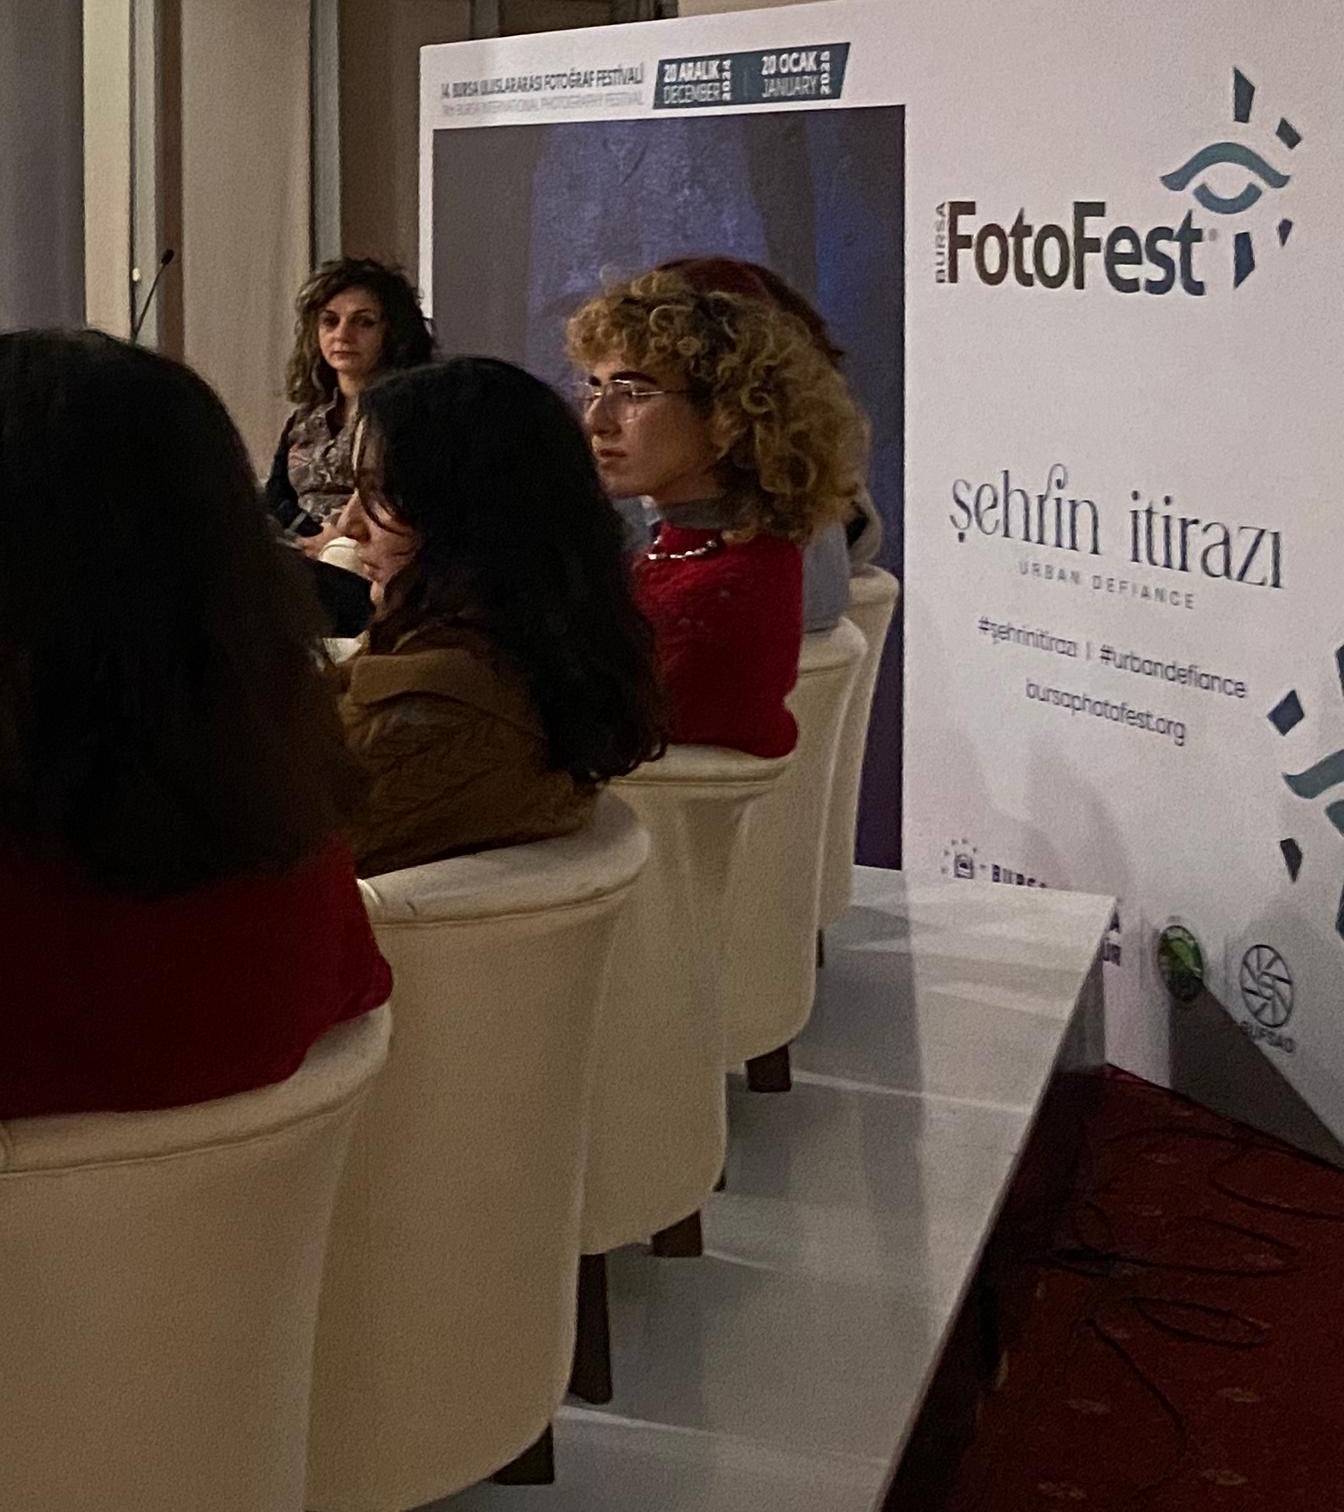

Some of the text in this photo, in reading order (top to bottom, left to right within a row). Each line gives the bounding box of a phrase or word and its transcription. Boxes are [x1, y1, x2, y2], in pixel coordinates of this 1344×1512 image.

[544, 68, 595, 90] FOTOĞRAF
[663, 60, 720, 83] 20 ARALIK
[761, 51, 818, 75] 20 OCAK
[663, 83, 721, 104] DECEMBER
[762, 74, 819, 98] JANUARY
[948, 200, 1207, 297] FotoFest
[1129, 490, 1284, 589] itirazı
[1018, 560, 1195, 609] URBAN DEFIANCE
[1099, 644, 1248, 698] #urbandefiance
[1025, 678, 1187, 747] bursaphotofest.org
